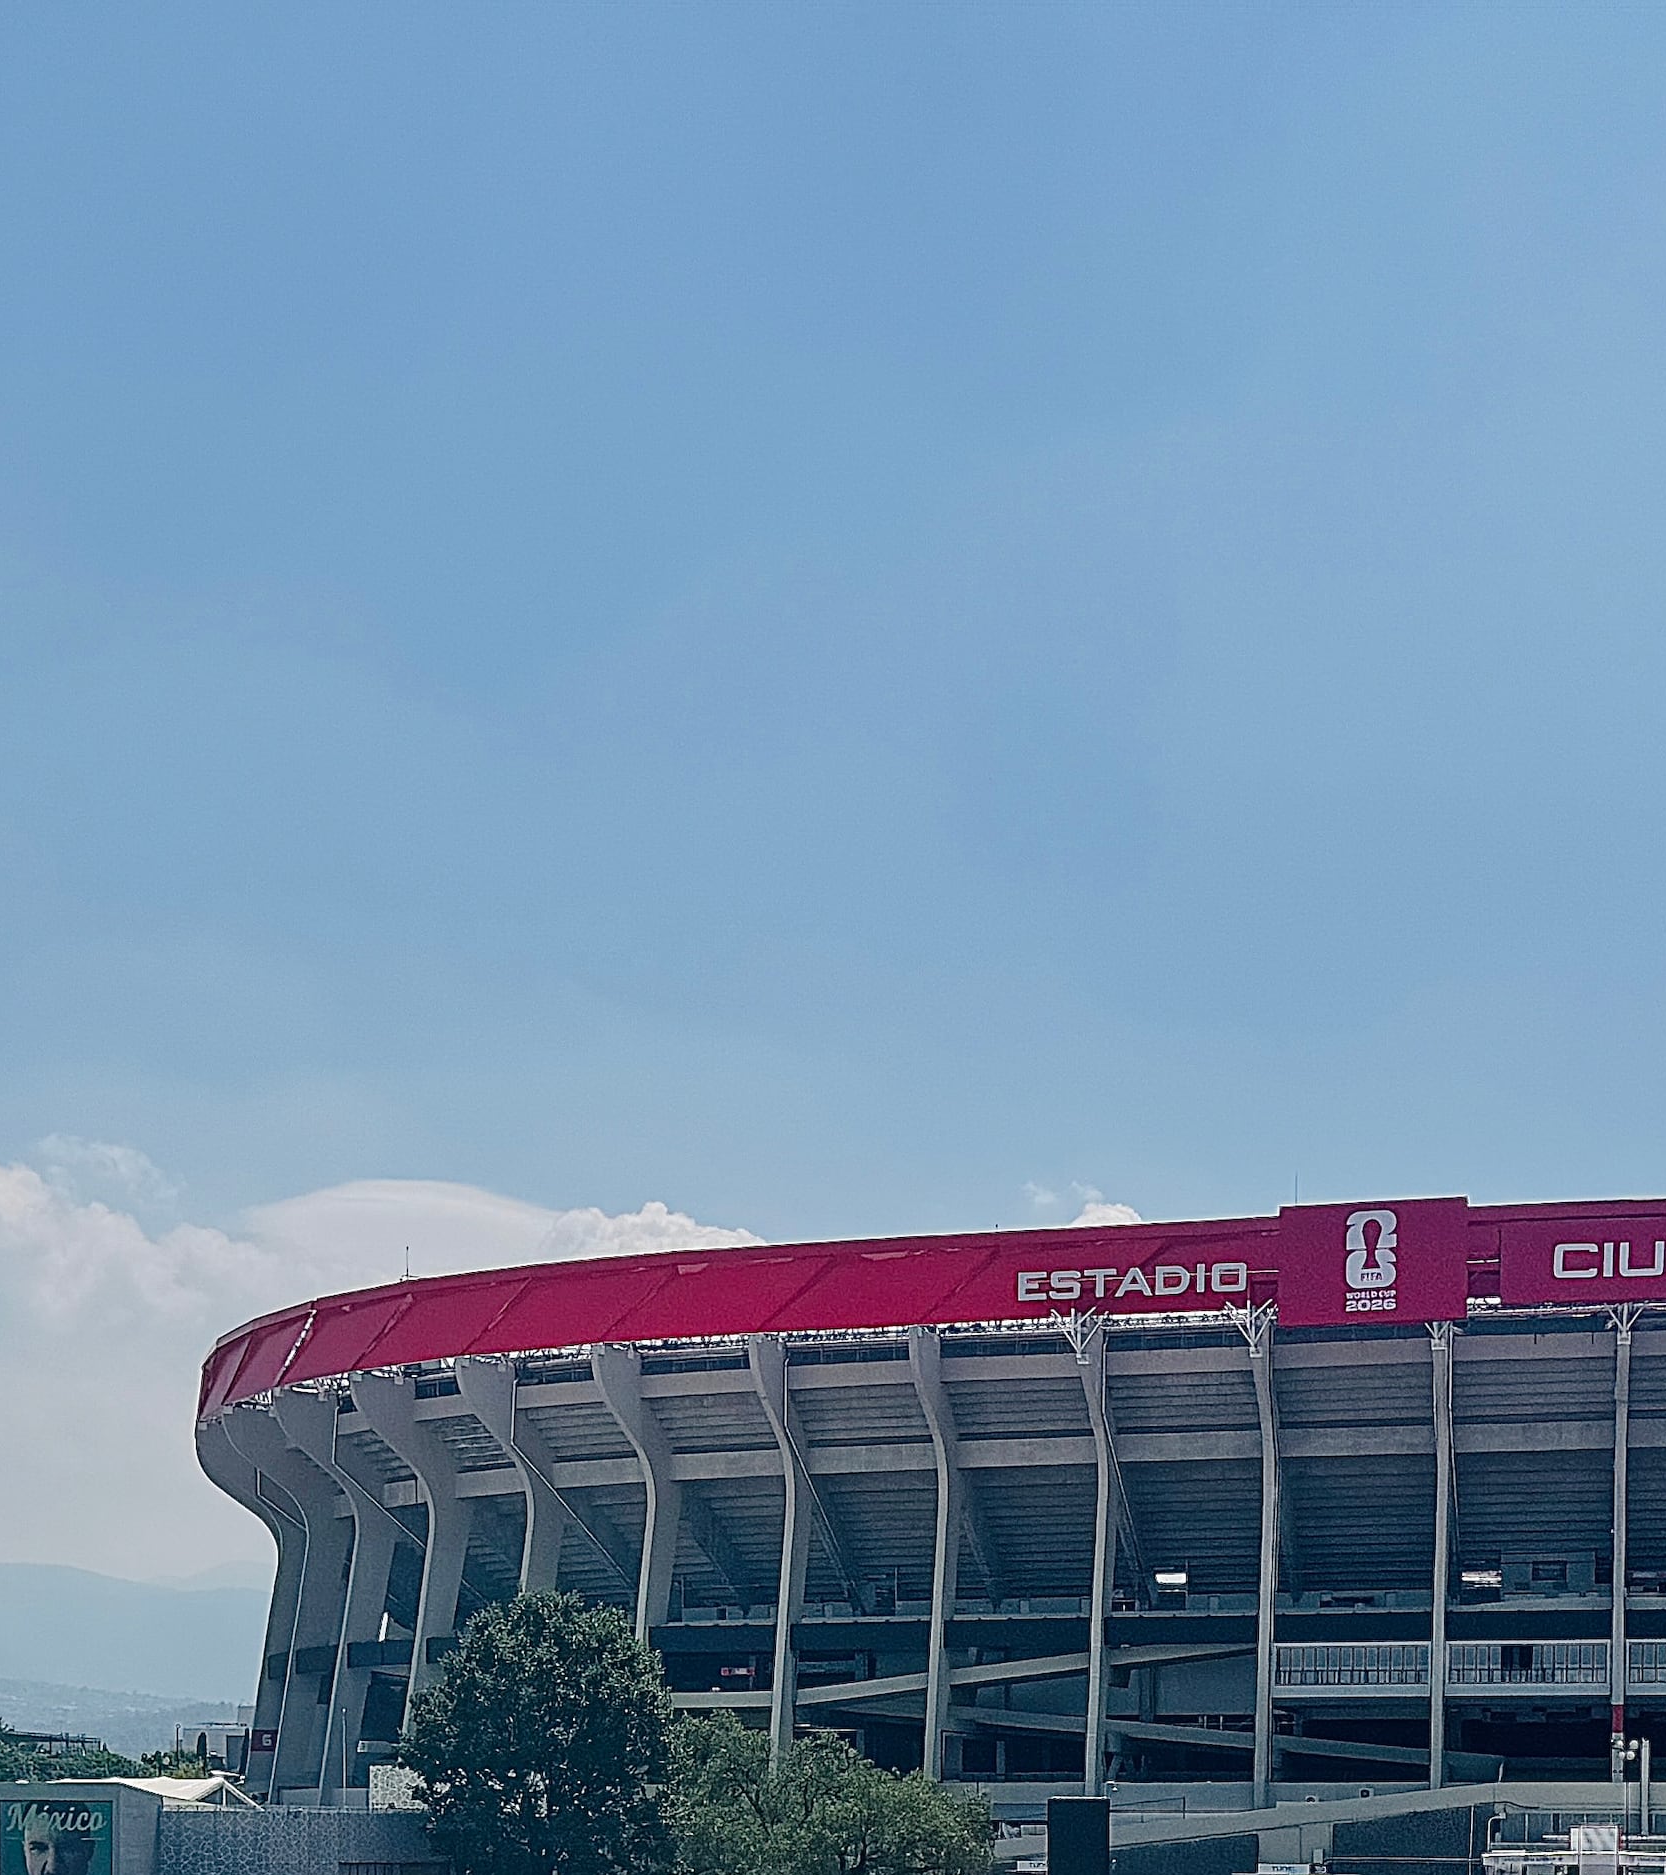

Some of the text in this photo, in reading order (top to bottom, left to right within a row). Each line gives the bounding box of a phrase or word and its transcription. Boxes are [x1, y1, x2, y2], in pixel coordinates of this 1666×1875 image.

[1017, 1262, 1248, 1302] ESTADIO
[1360, 1272, 1383, 1282] FIFA
[1345, 1289, 1397, 1300] WORLD CUP
[1345, 1298, 1397, 1312] 2026
[262, 1734, 272, 1746] 6
[5, 1803, 108, 1832] México
